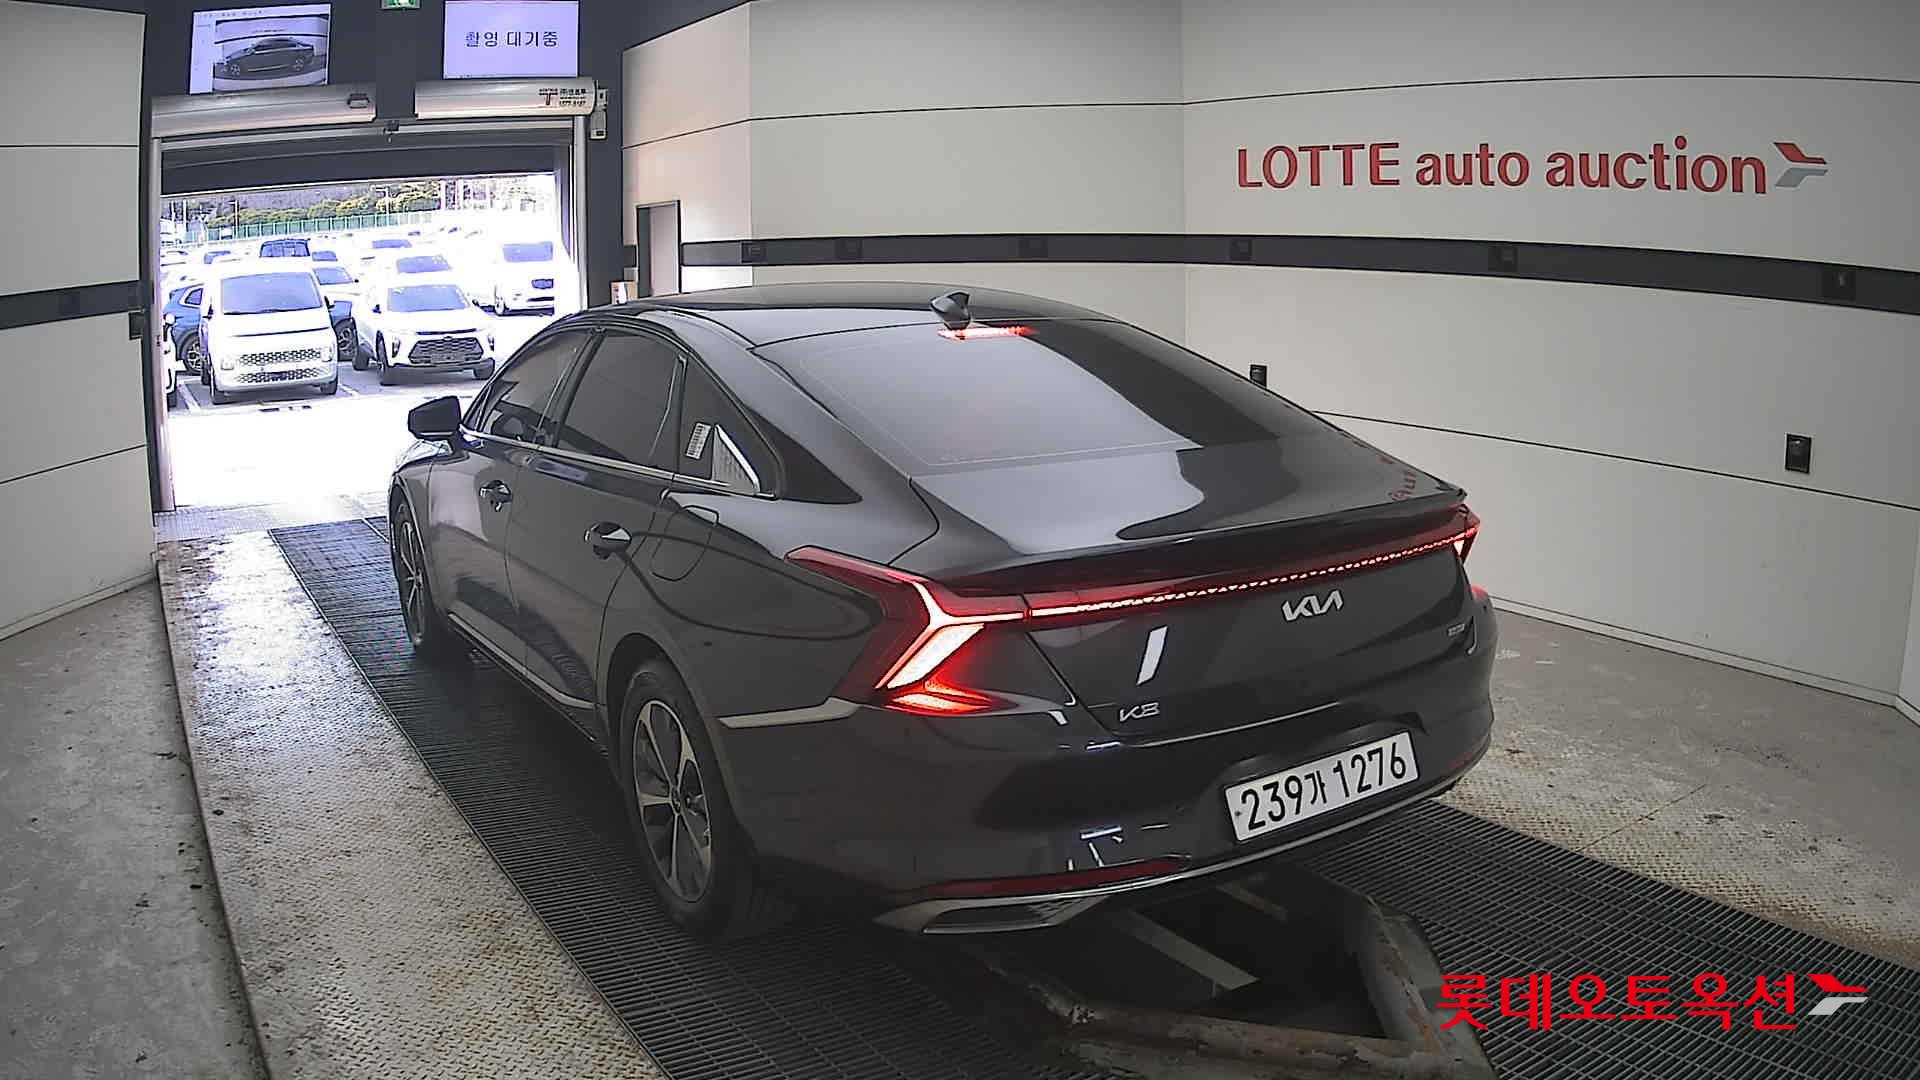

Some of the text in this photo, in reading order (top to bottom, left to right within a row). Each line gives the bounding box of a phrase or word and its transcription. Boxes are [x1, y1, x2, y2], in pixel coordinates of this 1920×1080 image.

[506, 31, 559, 48] 대기중
[1238, 137, 1767, 194] LOTTE auto auction
[1118, 701, 1161, 723] K8
[1240, 742, 1407, 831] 239가 1276
